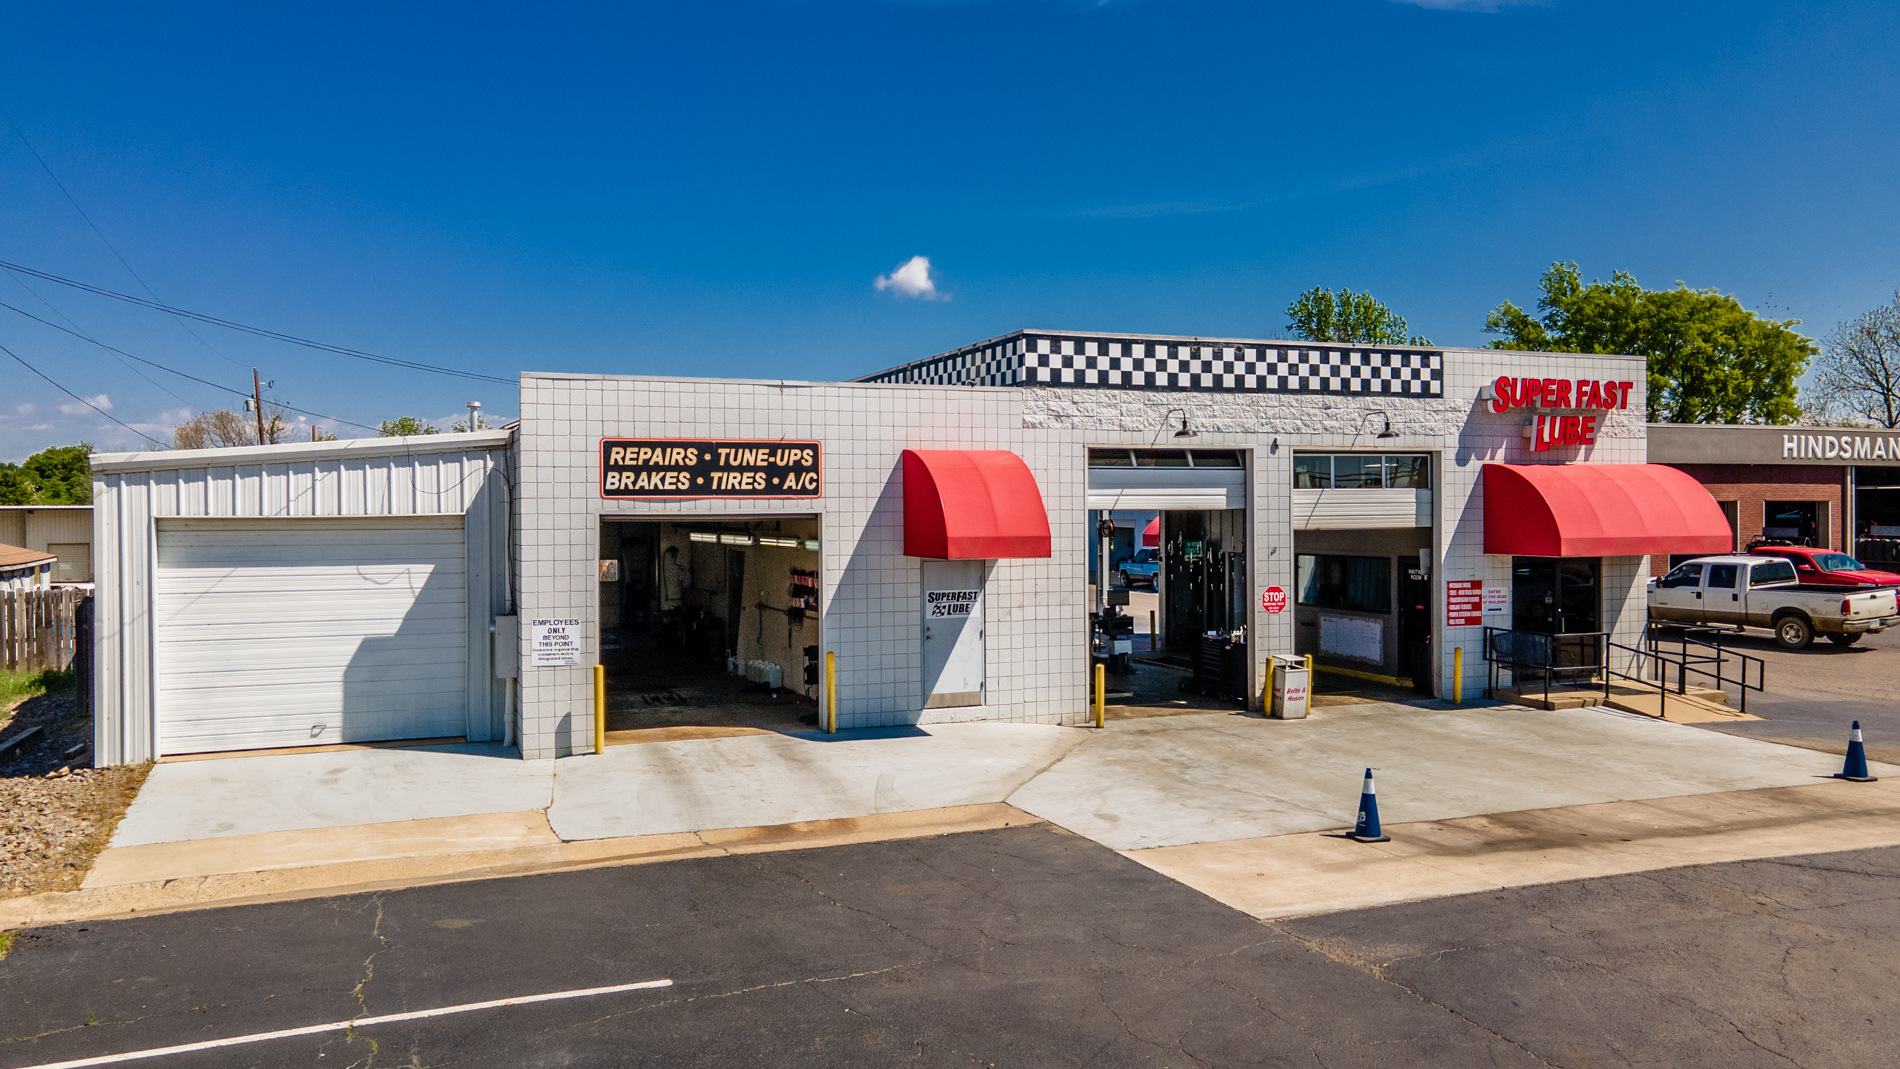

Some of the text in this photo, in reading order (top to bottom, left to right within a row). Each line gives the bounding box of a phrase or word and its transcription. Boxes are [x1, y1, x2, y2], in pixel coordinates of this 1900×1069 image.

[1492, 376, 1633, 413] SUPER FAST
[1534, 414, 1596, 452] LUBE
[609, 447, 814, 467] REPAIRS TUNE-UPS
[1782, 434, 1900, 460] HINDSMAN
[605, 471, 818, 491] BRAKES TIRES A/C
[928, 591, 978, 603] SUPERFAST
[1263, 591, 1285, 602] STOP
[947, 603, 971, 615] LUBE
